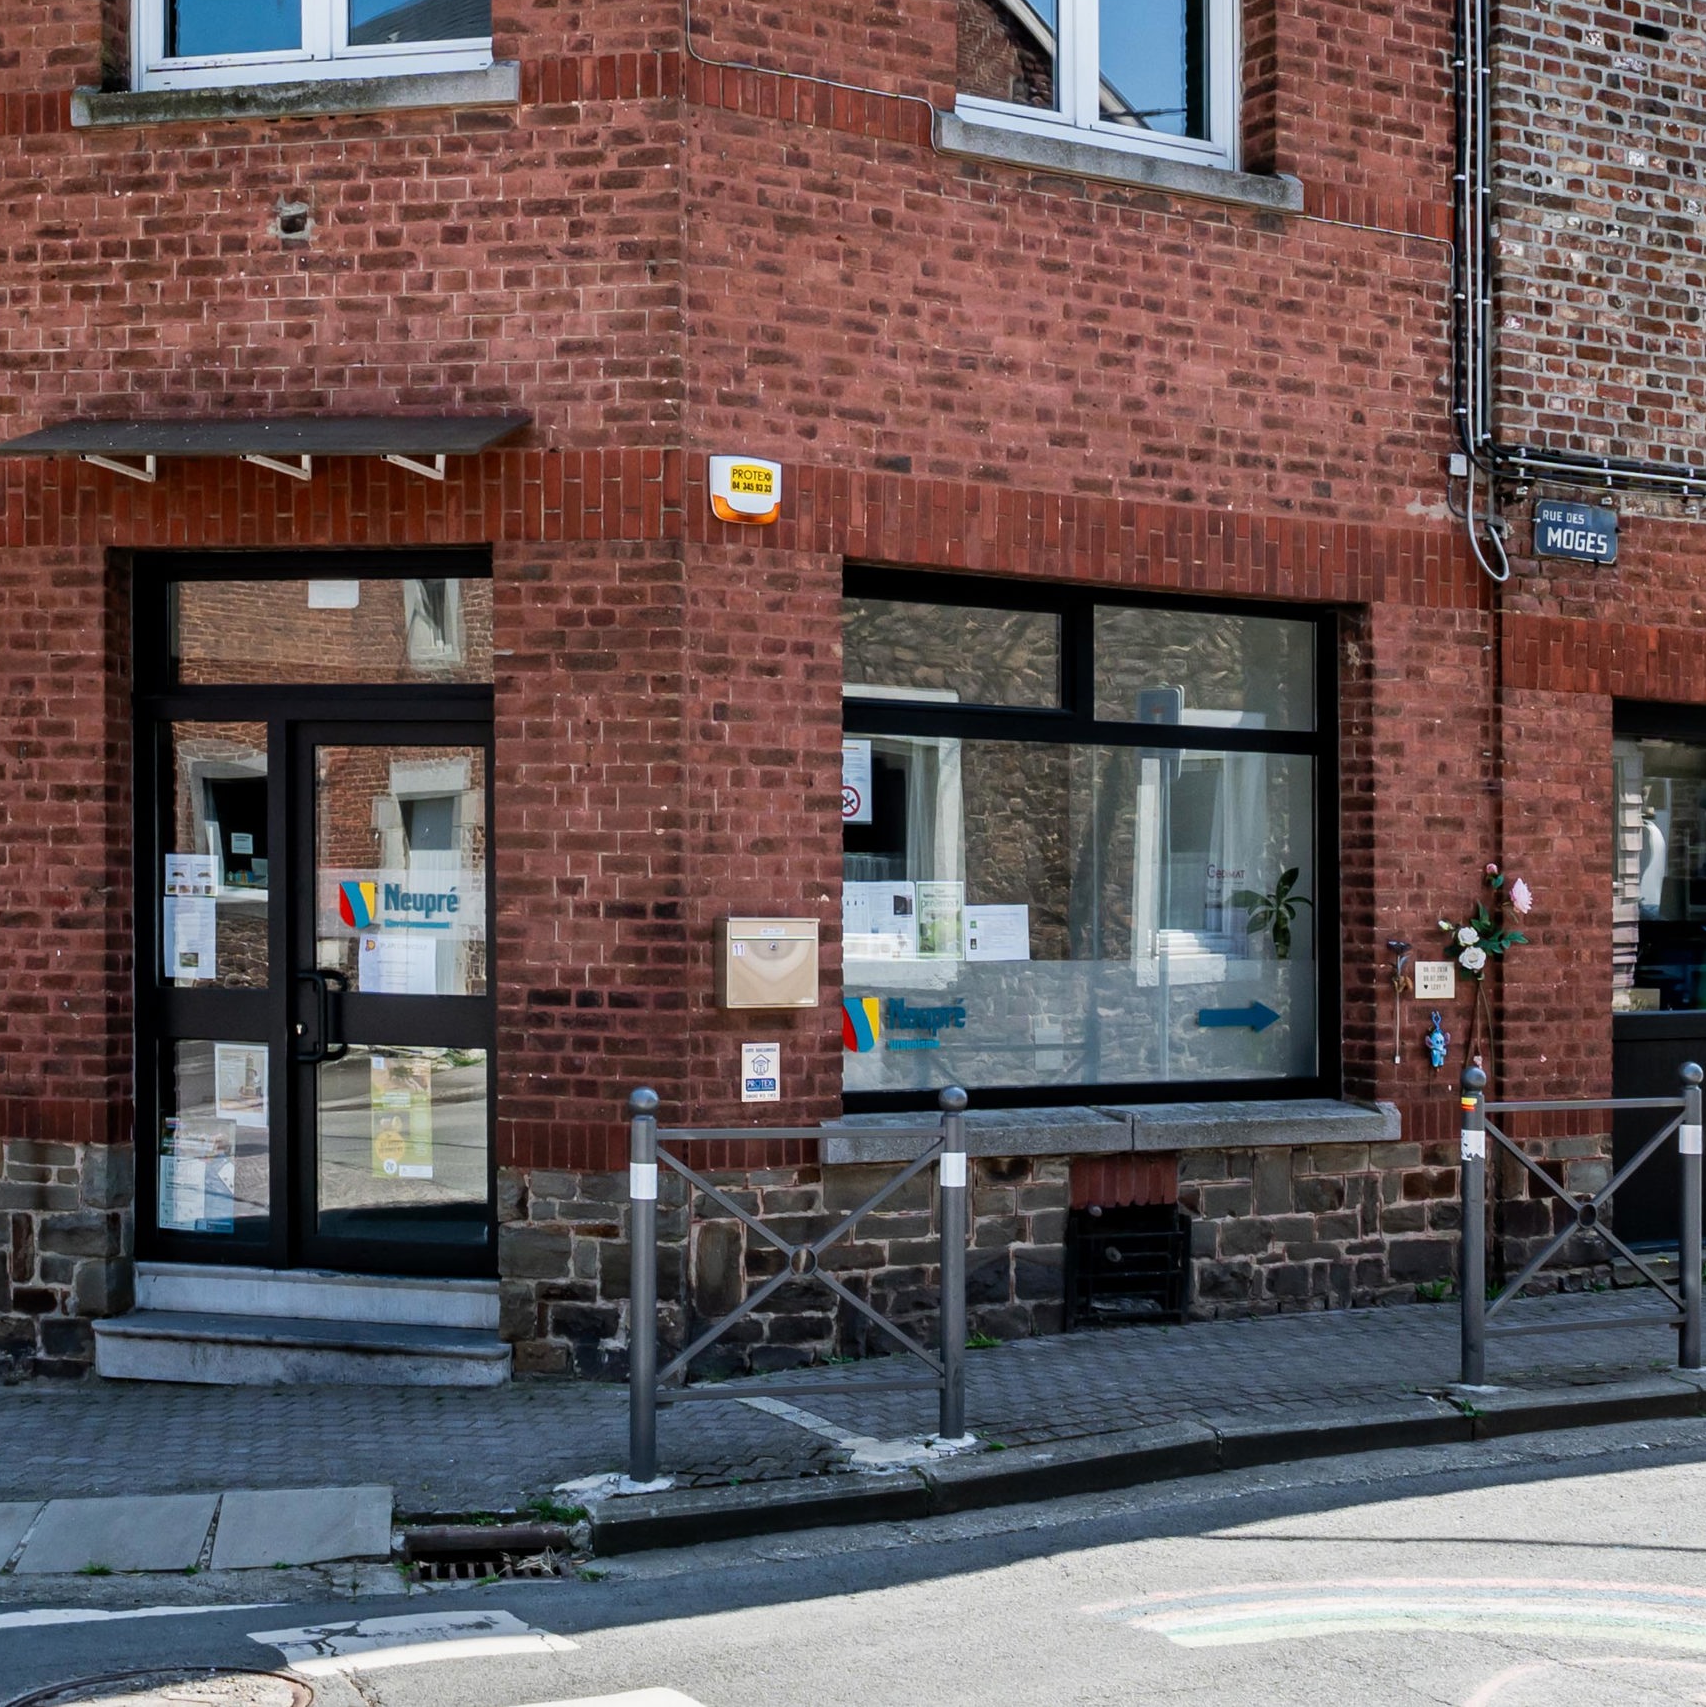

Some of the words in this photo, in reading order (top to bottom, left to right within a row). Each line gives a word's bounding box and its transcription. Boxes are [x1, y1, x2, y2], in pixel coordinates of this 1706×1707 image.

[1542, 509, 1563, 522] RUE
[1566, 512, 1585, 525] DES
[1546, 526, 1608, 555] MOGES
[384, 883, 460, 919] Neupré
[887, 996, 966, 1037] Neupré
